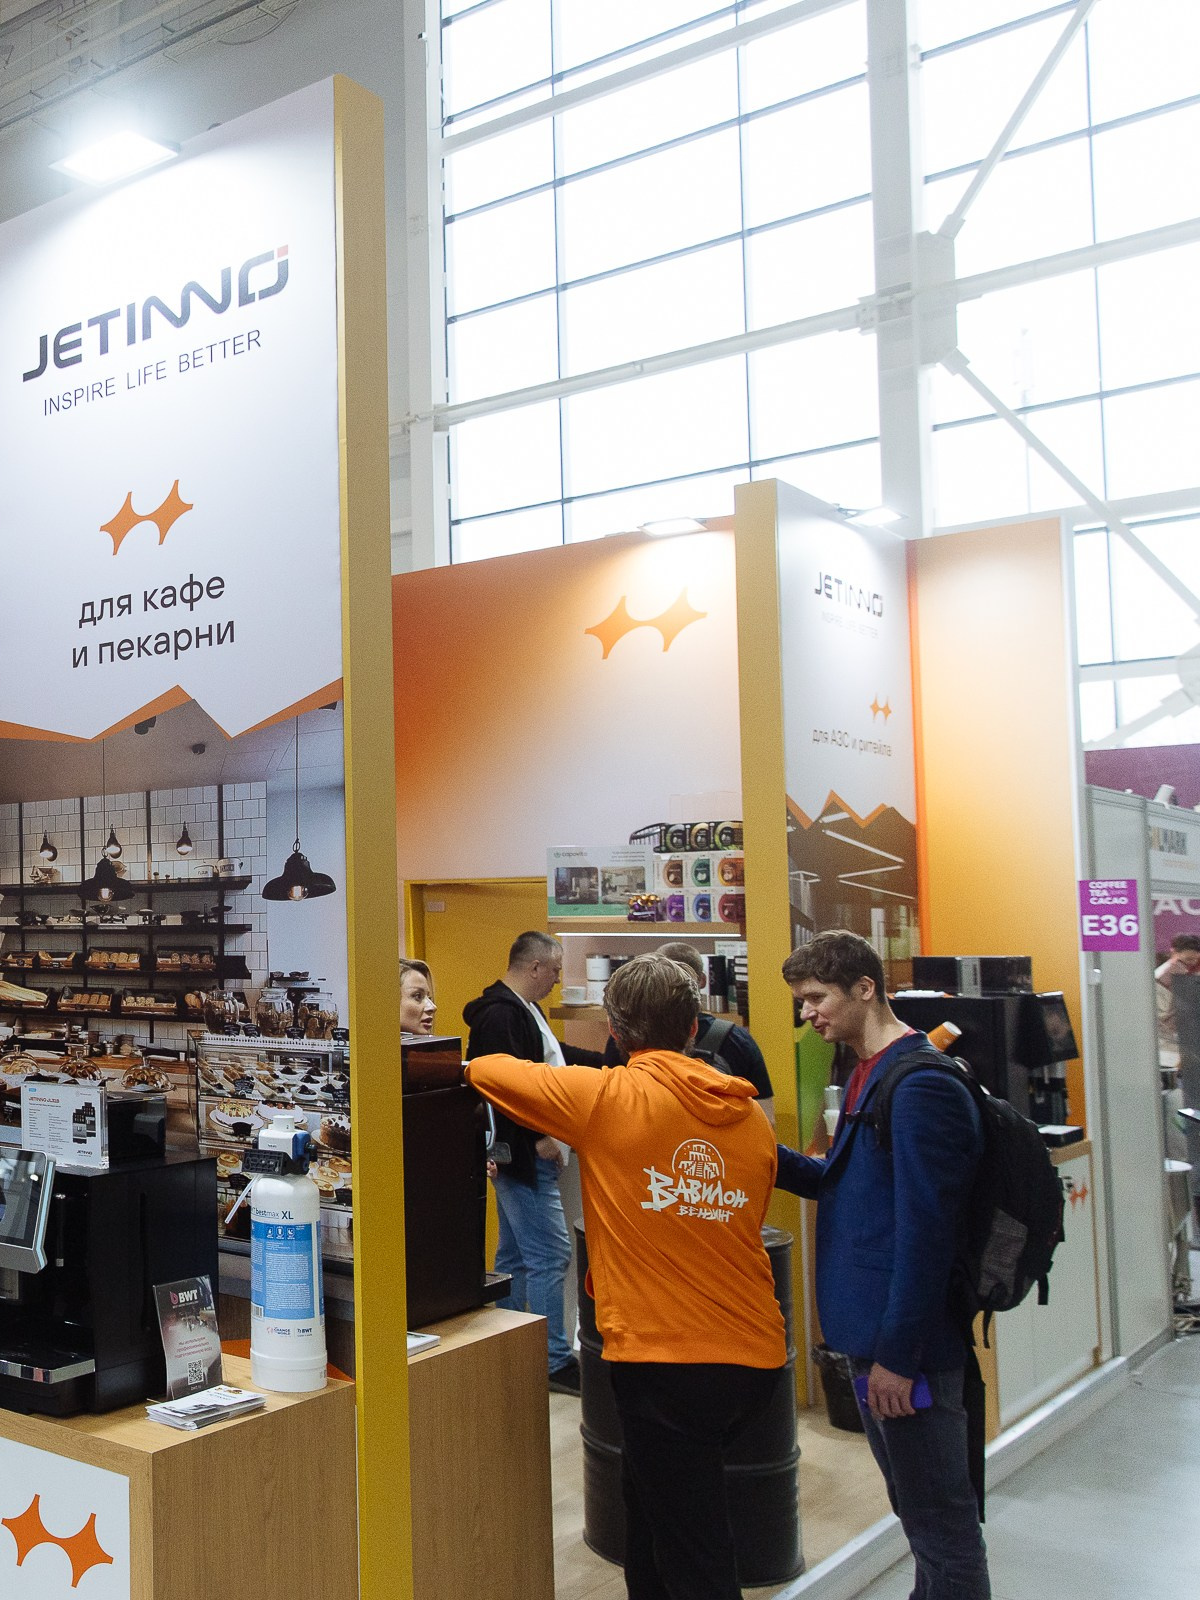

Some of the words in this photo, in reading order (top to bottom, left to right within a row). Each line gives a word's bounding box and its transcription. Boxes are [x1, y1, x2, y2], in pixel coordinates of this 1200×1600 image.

[22, 244, 289, 383] JETINNO
[44, 377, 116, 416] INSPIRE
[126, 360, 167, 390] LIFE
[179, 329, 261, 373] BETTER
[78, 593, 132, 629] для
[143, 573, 225, 612] кафе
[72, 646, 88, 668] и
[99, 620, 235, 661] пекарни
[1088, 881, 1128, 889] COFFEE
[1088, 889, 1109, 897] TEA
[1089, 896, 1129, 905] CACAO
[1081, 914, 1139, 937] E36
[281, 1210, 294, 1220] XL
[178, 1289, 198, 1304] BWT
